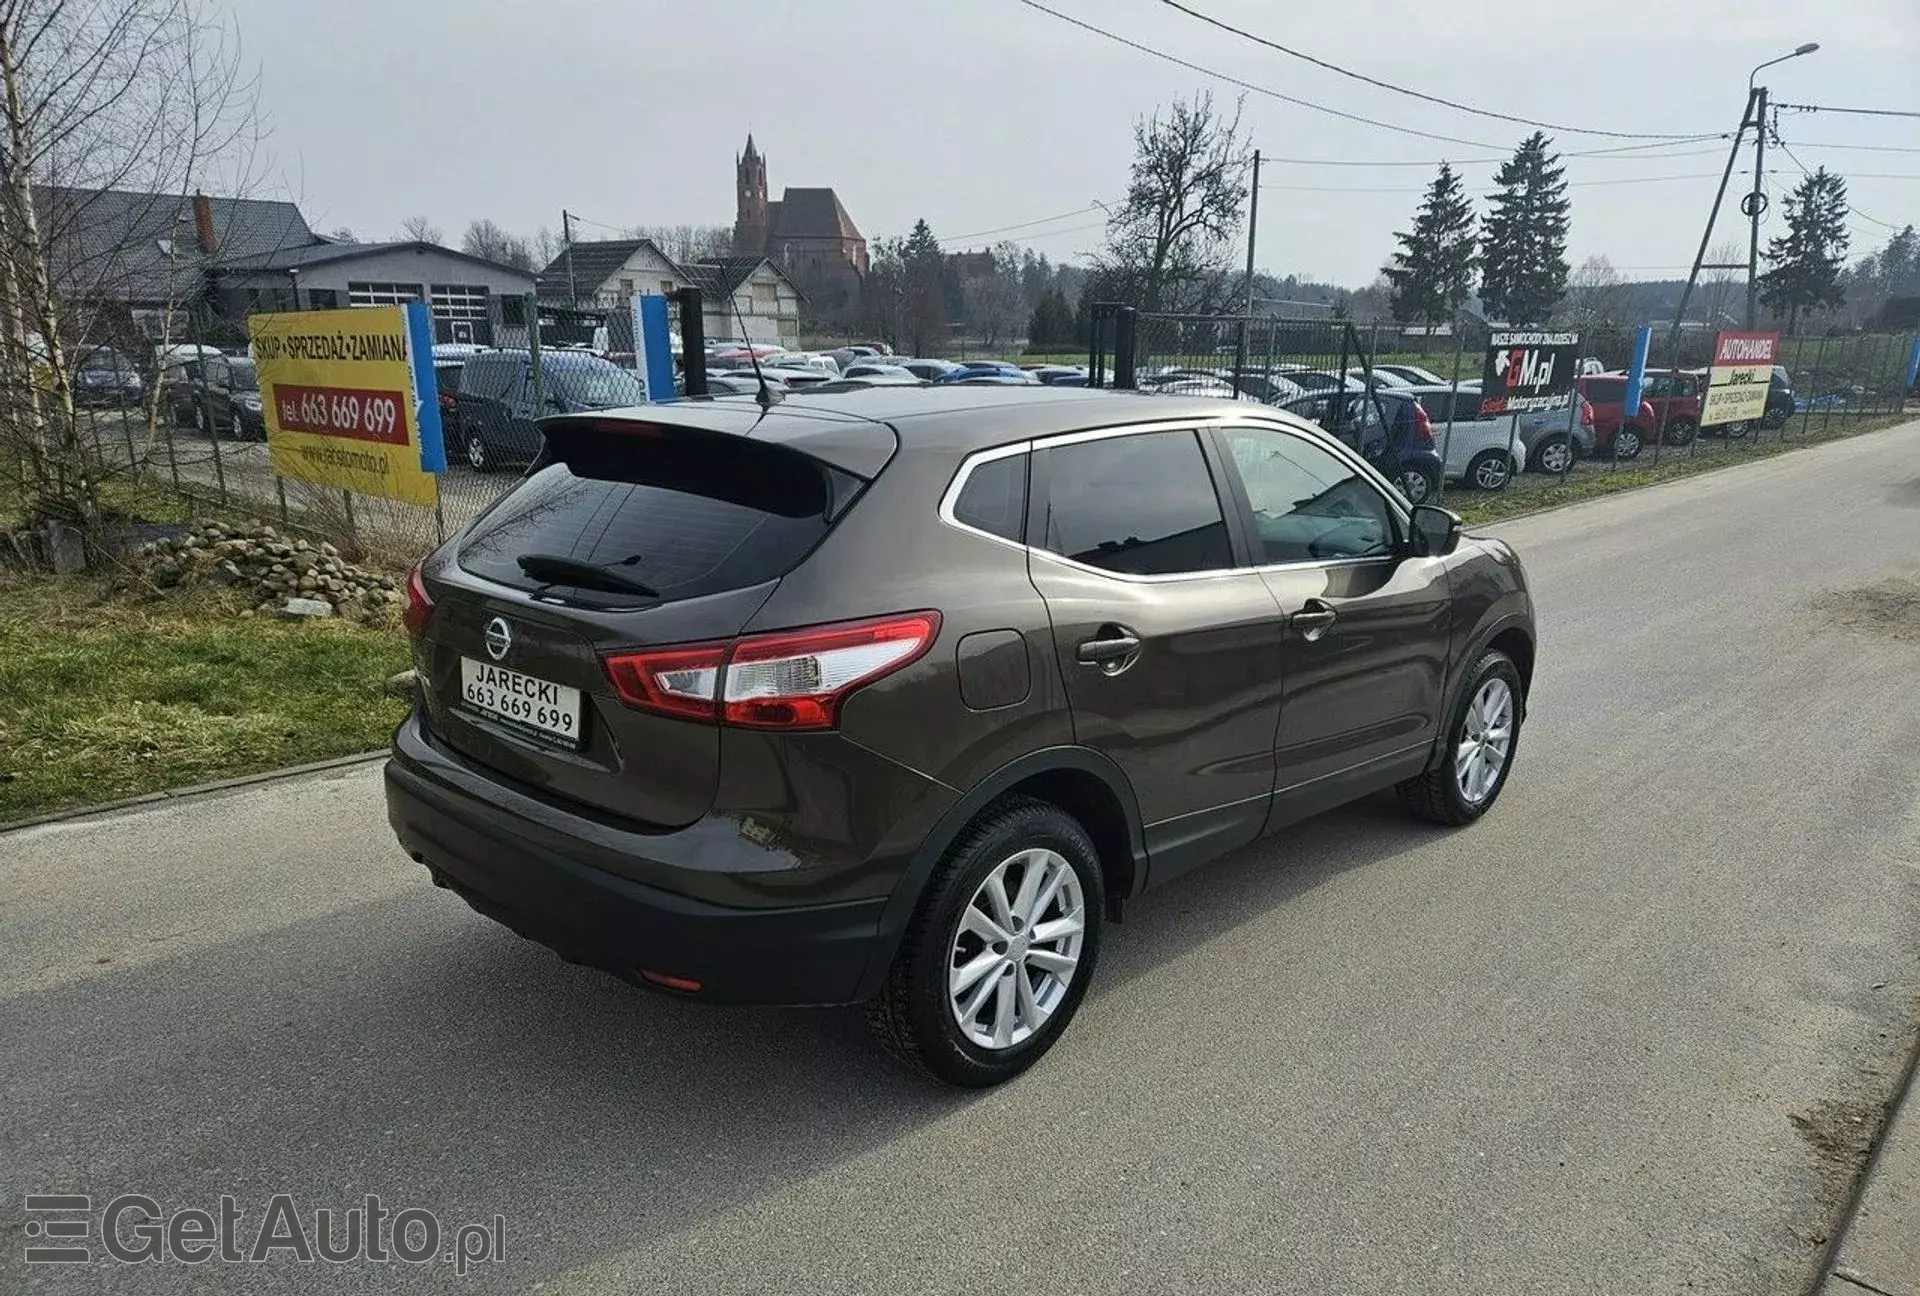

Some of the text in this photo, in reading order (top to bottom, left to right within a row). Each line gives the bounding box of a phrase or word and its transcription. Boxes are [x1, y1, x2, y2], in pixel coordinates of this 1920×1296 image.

[287, 329, 347, 360] SPRZEDAŻ
[1720, 338, 1773, 360] AUTOHANDEL
[1506, 348, 1556, 395] GM.pl
[301, 392, 328, 426] 663
[331, 395, 359, 430] 669
[364, 397, 396, 434] 699
[476, 664, 558, 706] JARECKI
[467, 683, 494, 707] 663
[500, 694, 531, 718] 669
[537, 706, 573, 732] 699
